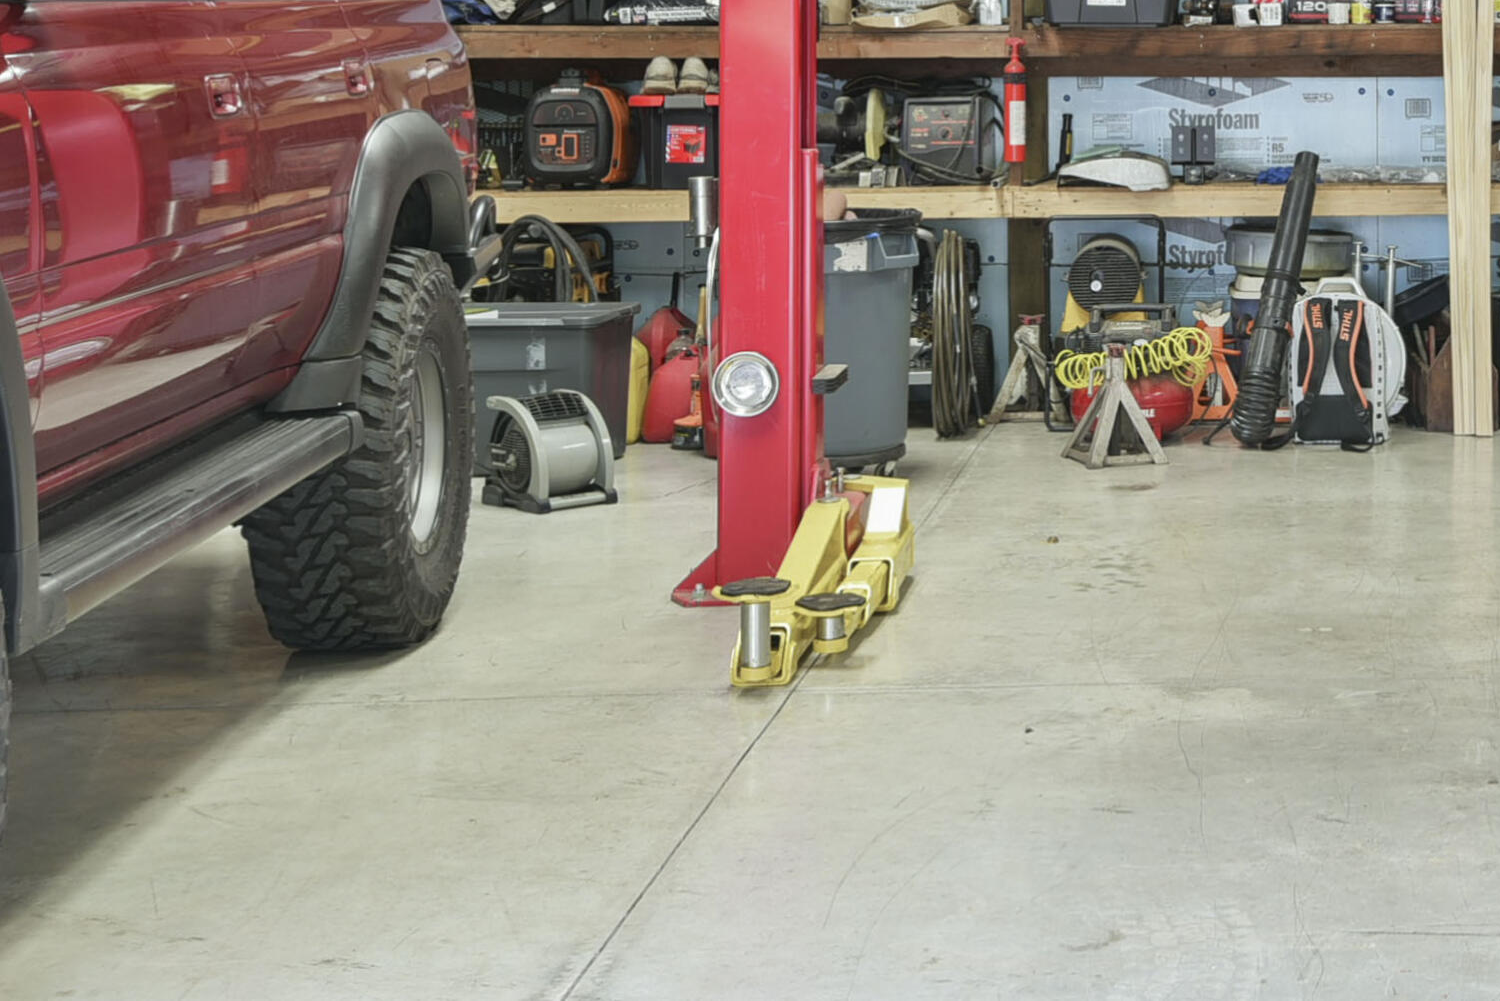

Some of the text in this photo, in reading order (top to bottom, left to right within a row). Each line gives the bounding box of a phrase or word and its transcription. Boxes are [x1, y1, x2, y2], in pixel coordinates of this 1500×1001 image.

[1169, 108, 1260, 130] Styrofoam
[1169, 244, 1224, 273] Styrof
[1311, 303, 1323, 328] STIHL
[1340, 309, 1354, 341] STIHL
